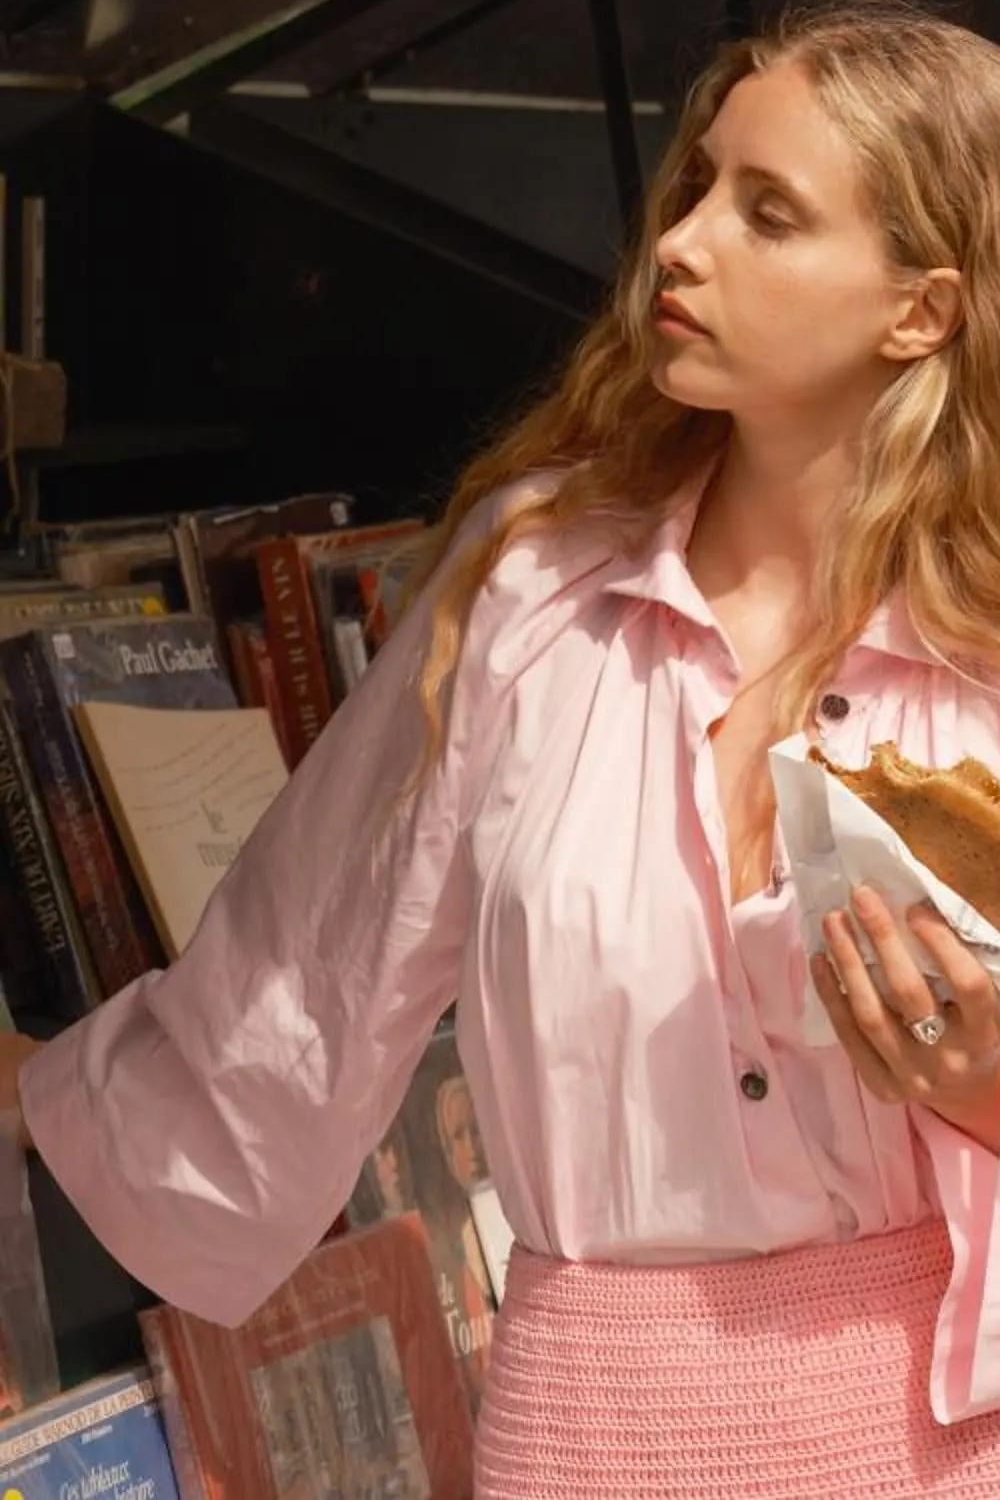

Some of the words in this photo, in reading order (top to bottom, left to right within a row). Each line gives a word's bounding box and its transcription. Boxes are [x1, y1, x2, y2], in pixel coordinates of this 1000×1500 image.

[272, 557, 291, 600] VIN
[120, 643, 160, 676] Paul
[159, 639, 218, 674] Gachet
